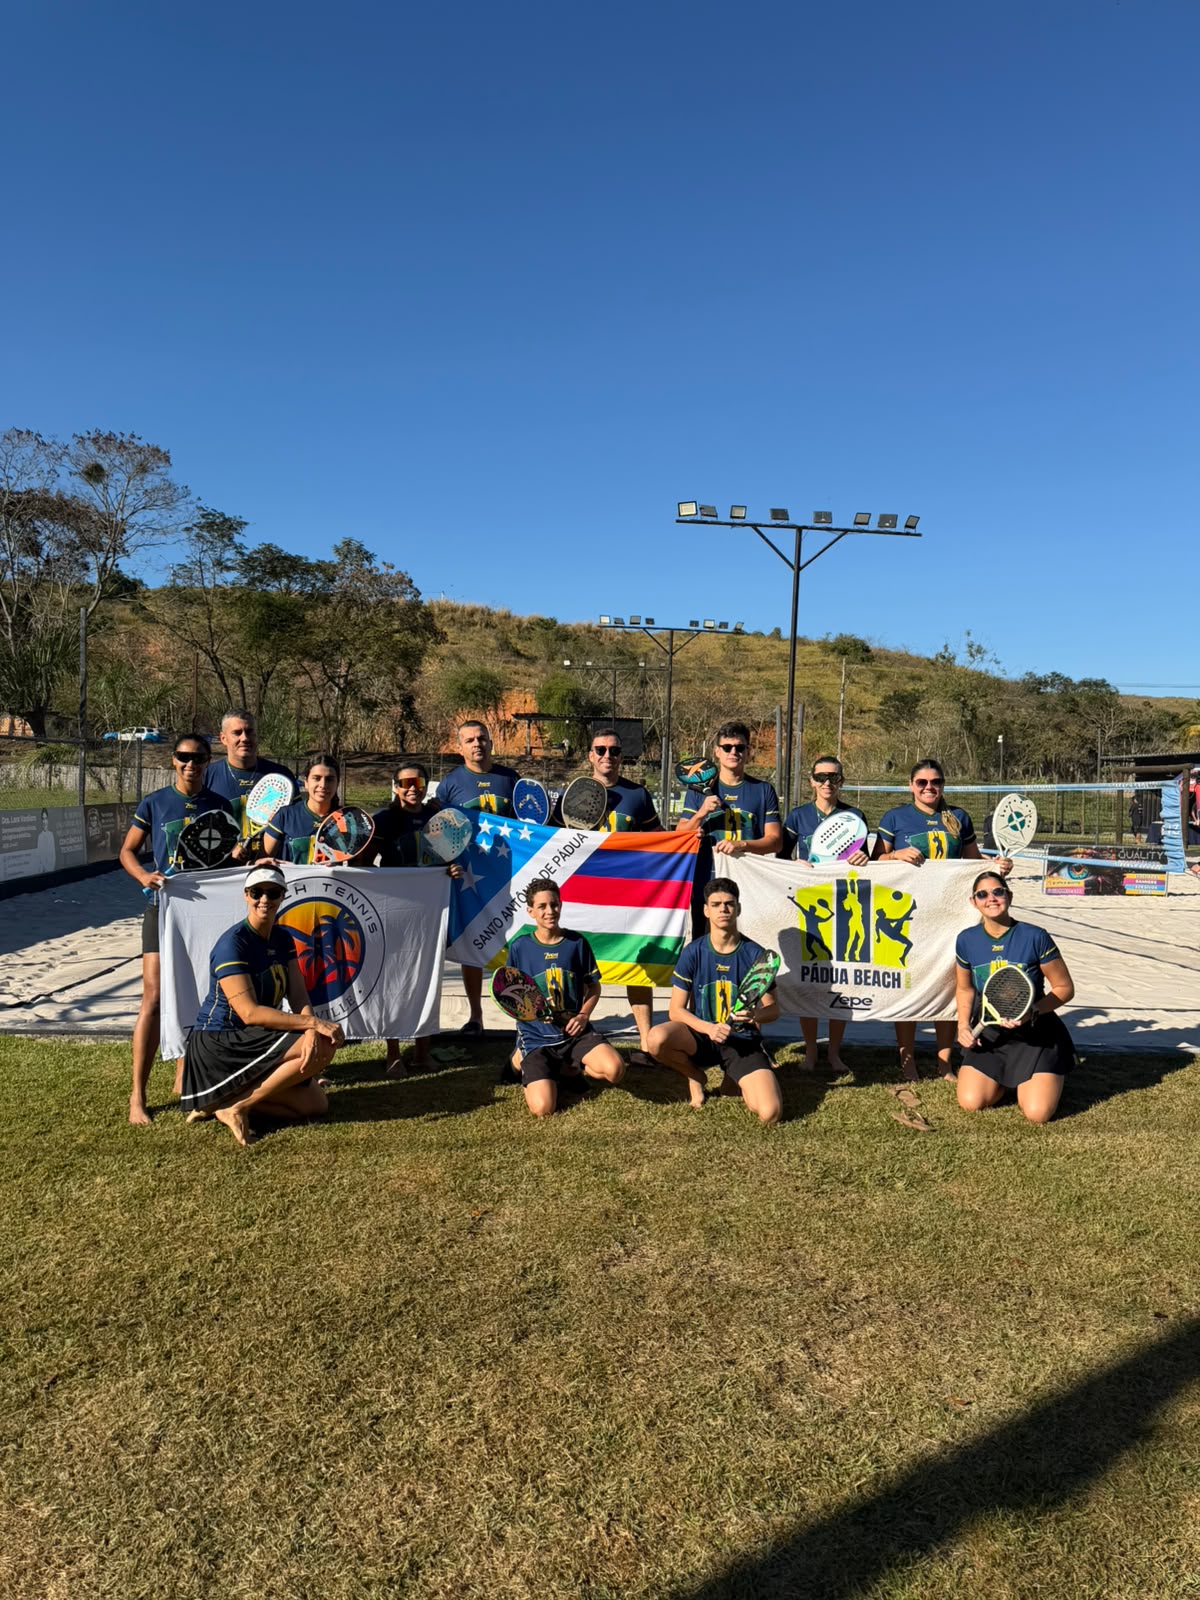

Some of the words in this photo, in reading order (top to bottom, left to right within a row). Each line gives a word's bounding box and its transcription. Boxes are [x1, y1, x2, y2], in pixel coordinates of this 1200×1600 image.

[1118, 849, 1164, 860] QUALITY
[473, 917, 504, 950] SANTO
[538, 863, 558, 880] DE
[552, 832, 589, 868] PÁDUA
[322, 882, 378, 934] TENNIS
[801, 963, 848, 985] PÁDUA
[854, 969, 901, 989] BEACH
[827, 991, 873, 1011] Zepe
